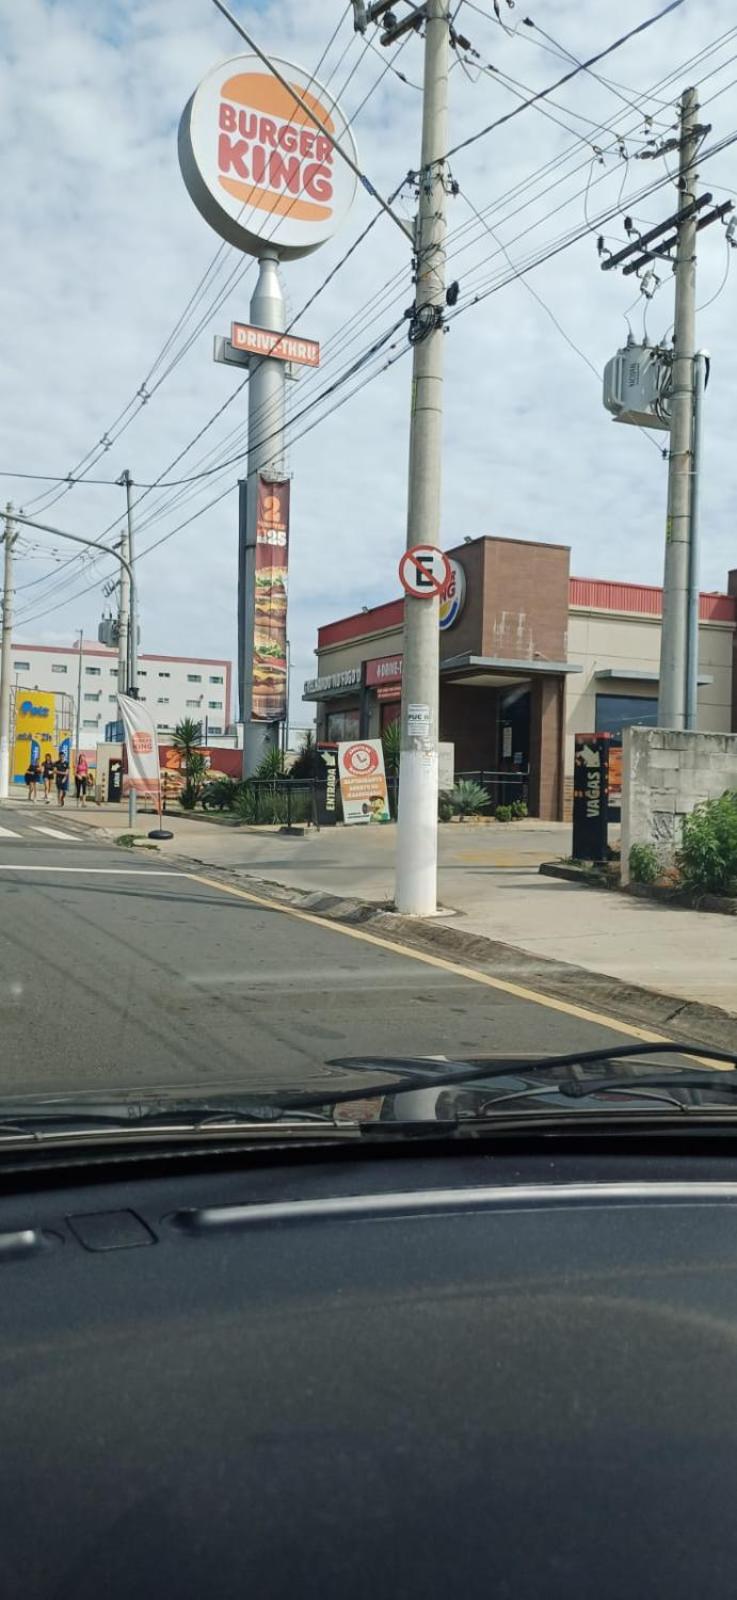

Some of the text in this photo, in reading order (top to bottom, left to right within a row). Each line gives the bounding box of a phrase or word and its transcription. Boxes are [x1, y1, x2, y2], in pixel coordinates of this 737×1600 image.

[218, 103, 334, 165] BURGER
[217, 133, 333, 202] KING
[237, 327, 316, 361] DRIVE-THRU
[263, 496, 281, 522] 2
[416, 556, 433, 586] E
[326, 768, 336, 811] ENTRADA
[586, 771, 601, 818] VAGAS
